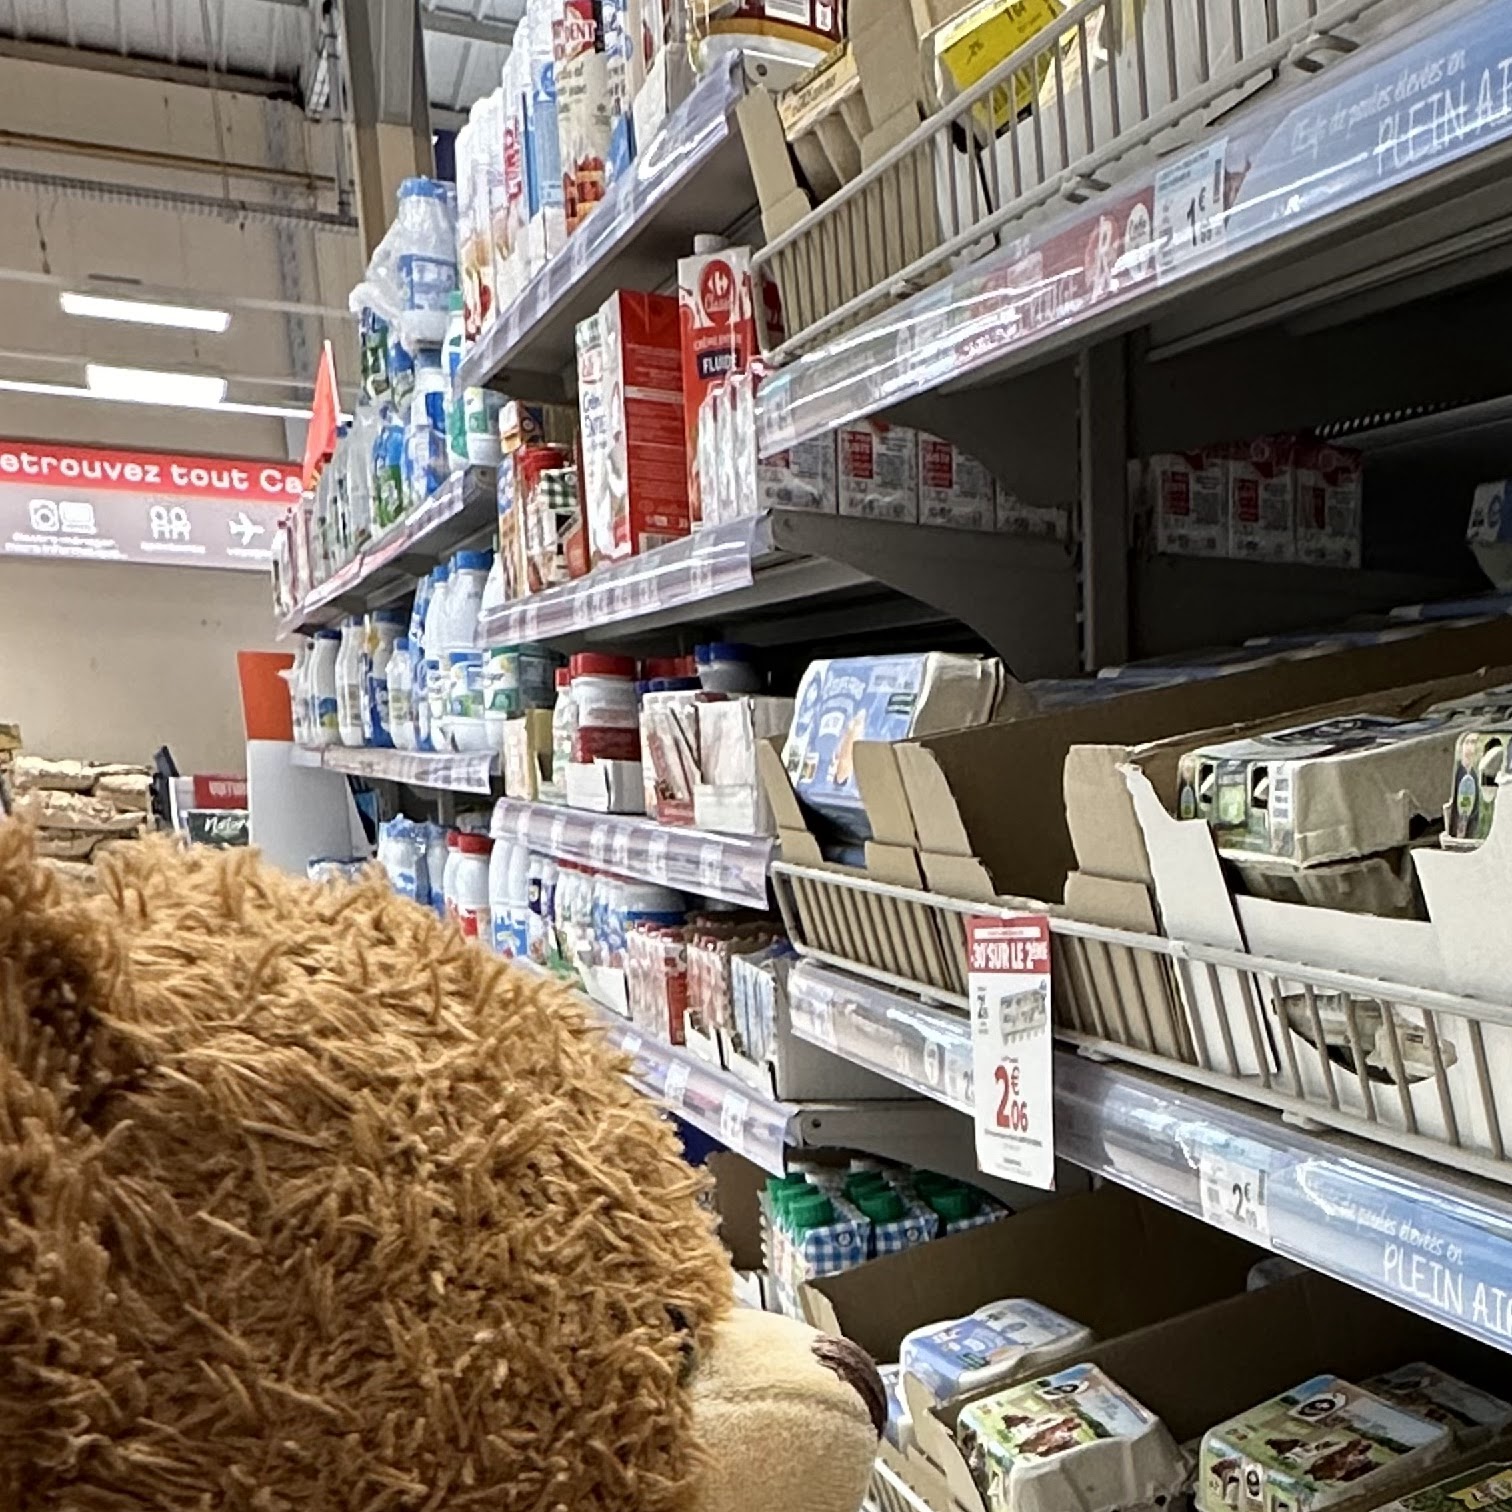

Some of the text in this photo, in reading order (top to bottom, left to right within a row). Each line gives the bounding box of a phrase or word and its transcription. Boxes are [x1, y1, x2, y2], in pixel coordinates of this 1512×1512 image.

[170, 463, 249, 491] tout
[994, 1064, 1011, 1128] 2
[1383, 1240, 1466, 1317] PLEIN
